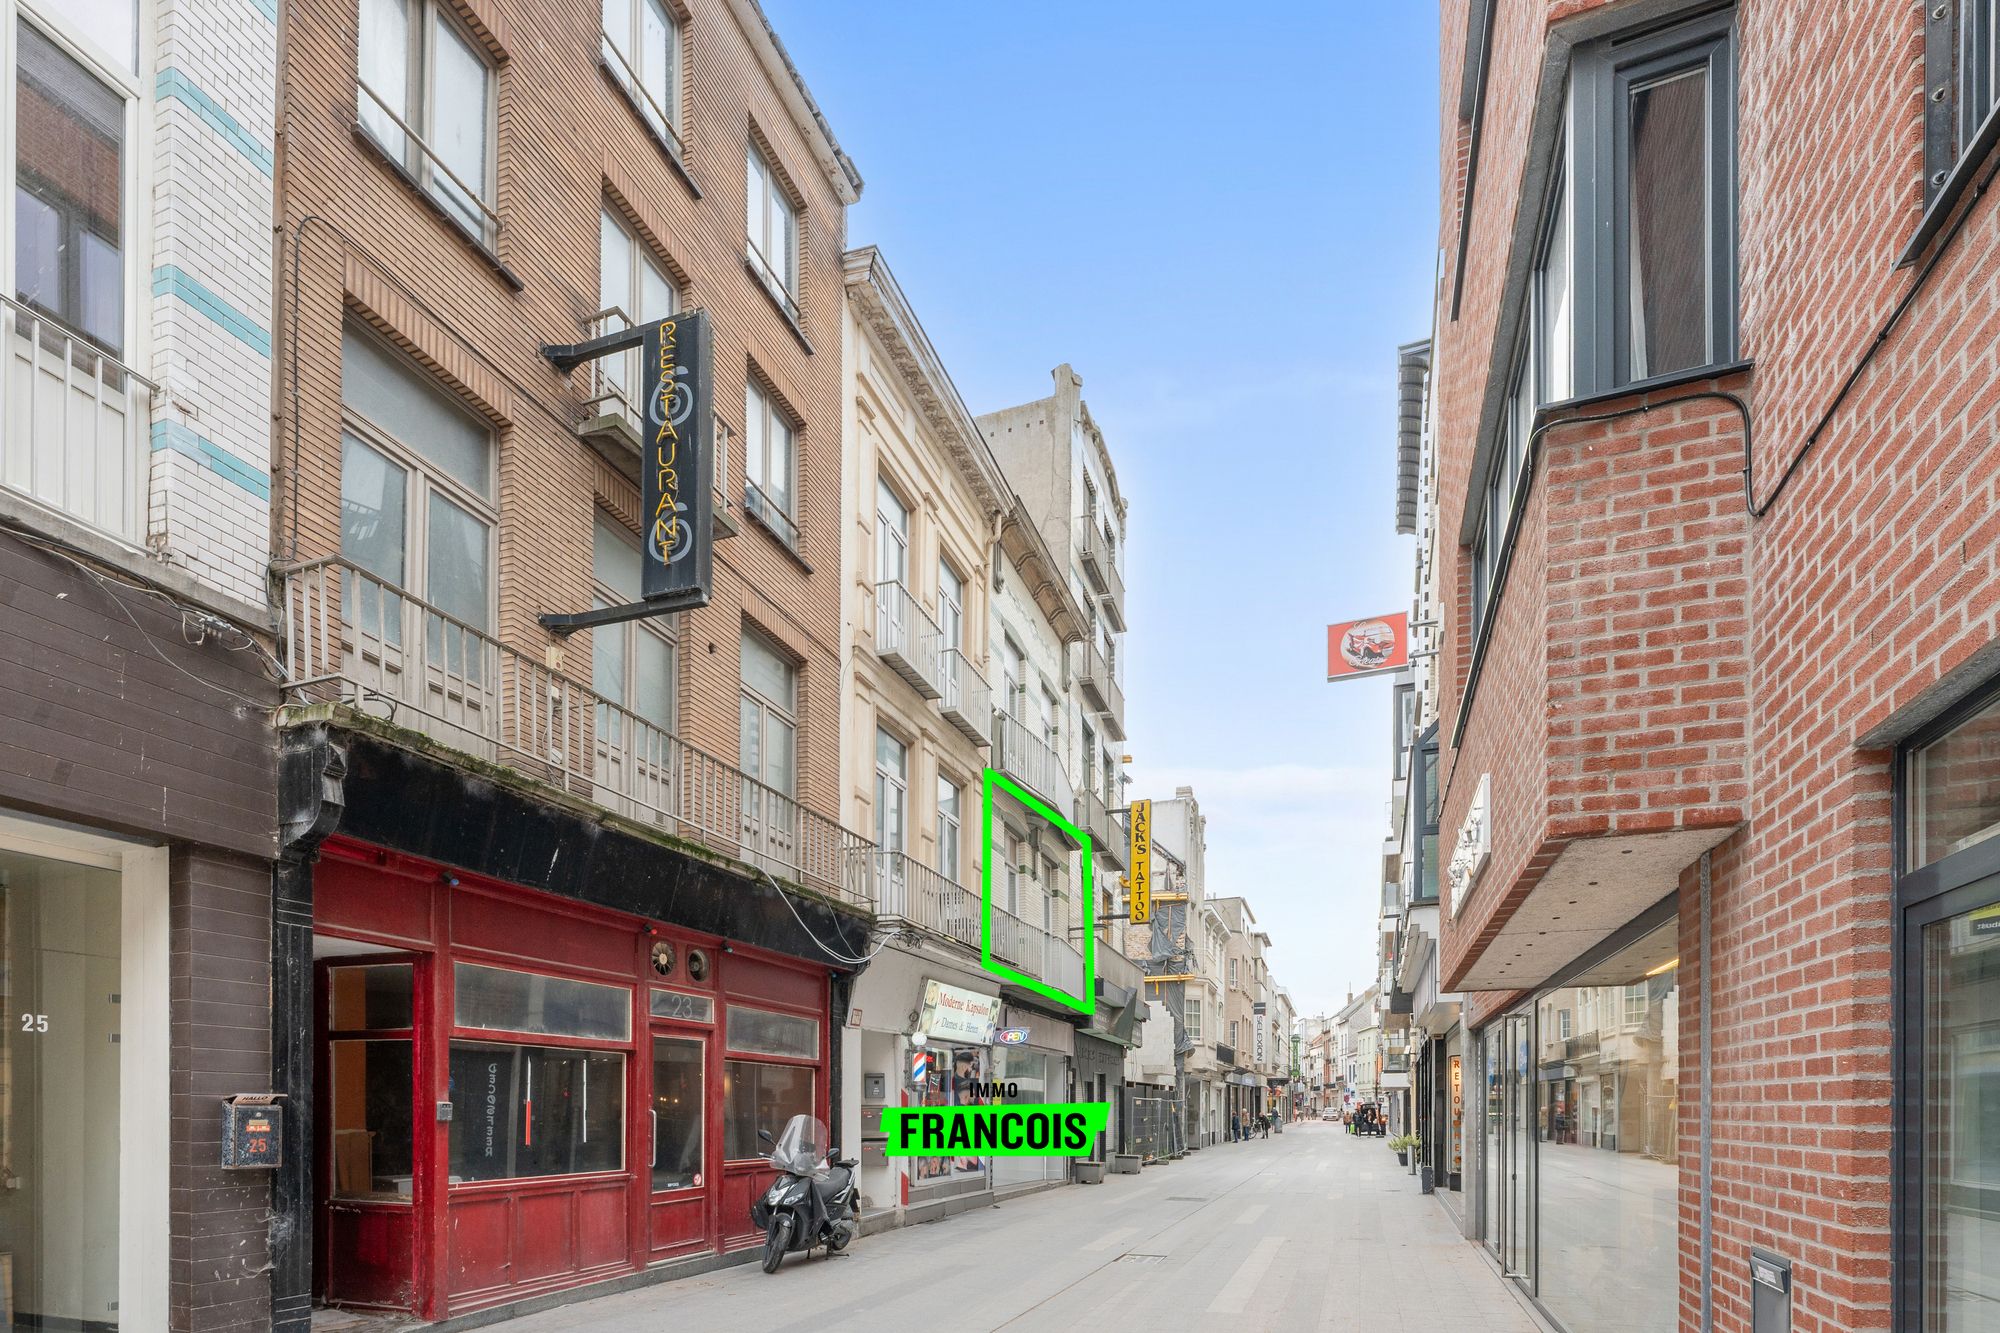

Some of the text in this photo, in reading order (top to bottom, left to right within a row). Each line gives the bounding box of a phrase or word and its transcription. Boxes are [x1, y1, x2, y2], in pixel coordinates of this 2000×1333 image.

[655, 321, 679, 565] RESTAURANT
[1134, 802, 1147, 921] JACK'S TATTOO
[671, 995, 693, 1019] 23
[938, 992, 989, 1016] Moderne Kapsalon
[21, 1013, 49, 1033] 25
[1002, 1032, 1025, 1041] OPEN
[249, 1138, 267, 1153] 25
